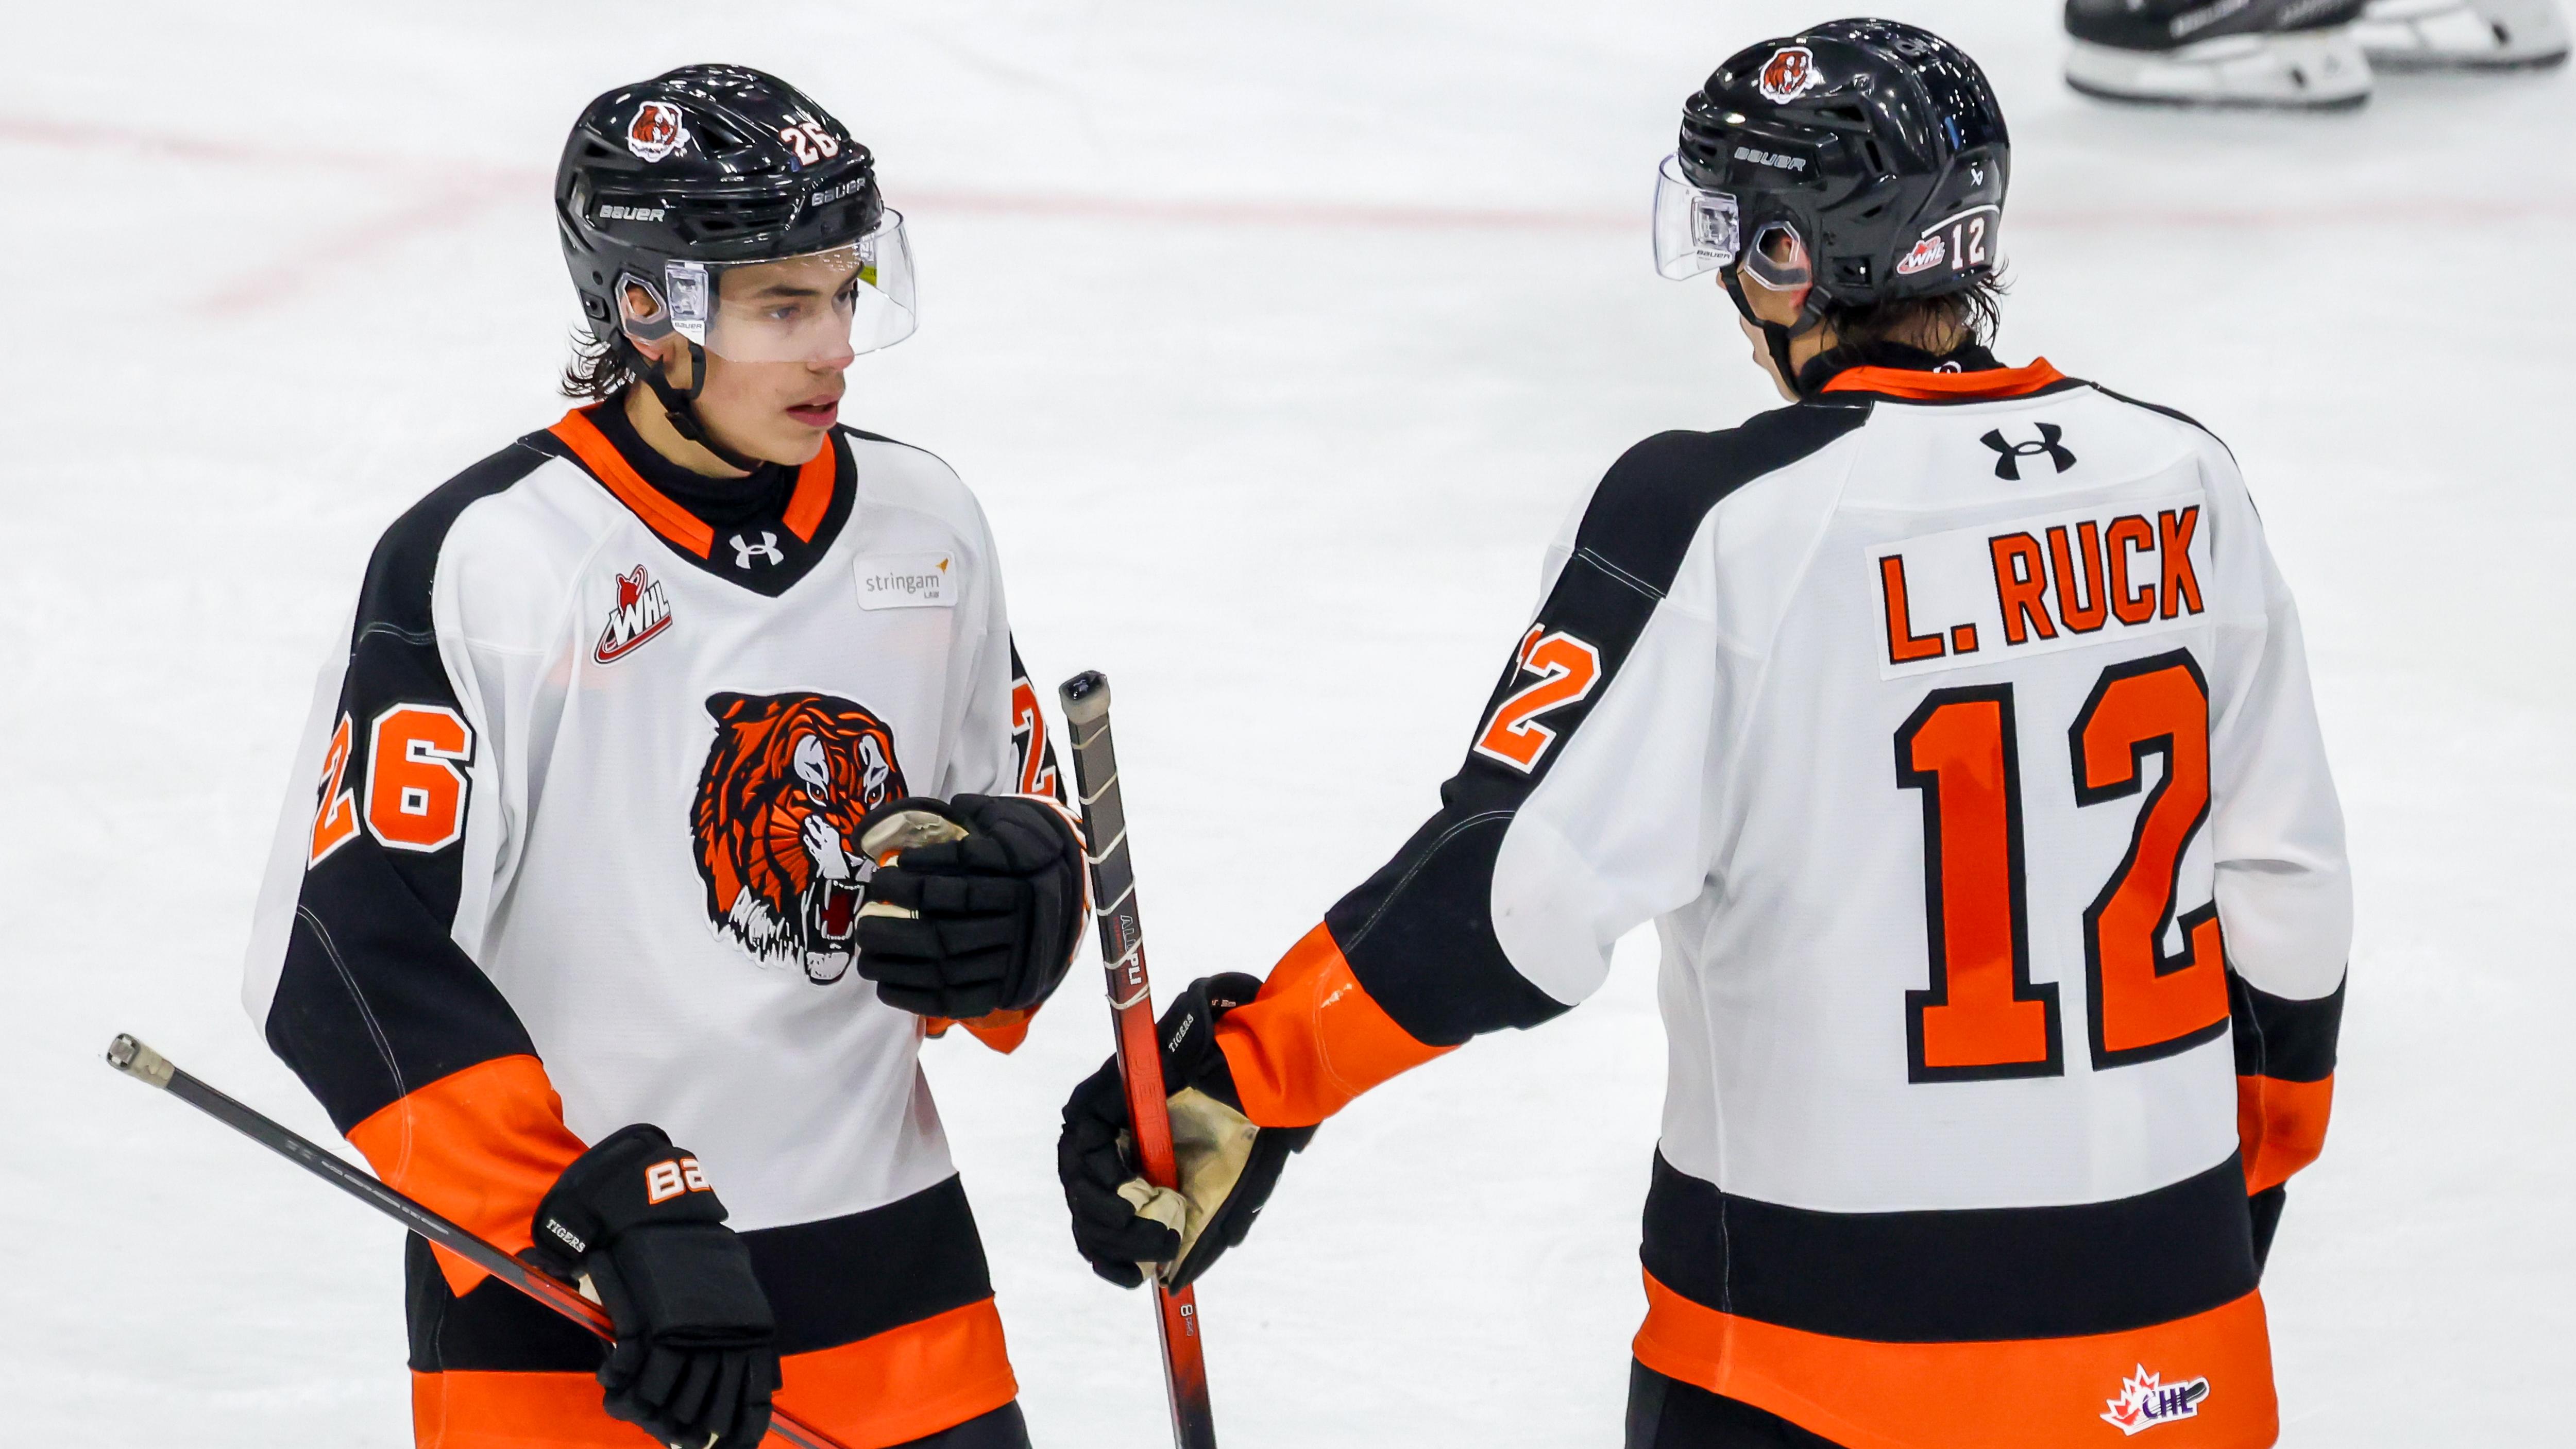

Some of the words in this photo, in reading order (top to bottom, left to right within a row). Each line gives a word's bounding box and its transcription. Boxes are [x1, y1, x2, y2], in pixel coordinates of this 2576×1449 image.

[778, 122, 841, 167] 26
[1907, 242, 1945, 267] WHL
[1951, 216, 1985, 271] 12
[866, 572, 939, 594] stringam
[1879, 553, 1979, 665] L.
[1988, 504, 2205, 647] RUCK
[609, 579, 671, 647] WHL
[308, 702, 472, 871] 26
[1893, 646, 2231, 1085] 12
[1168, 1013, 1194, 1053] TIGERS
[546, 1219, 586, 1253] TIGERS
[2142, 1387, 2193, 1420] CHL
